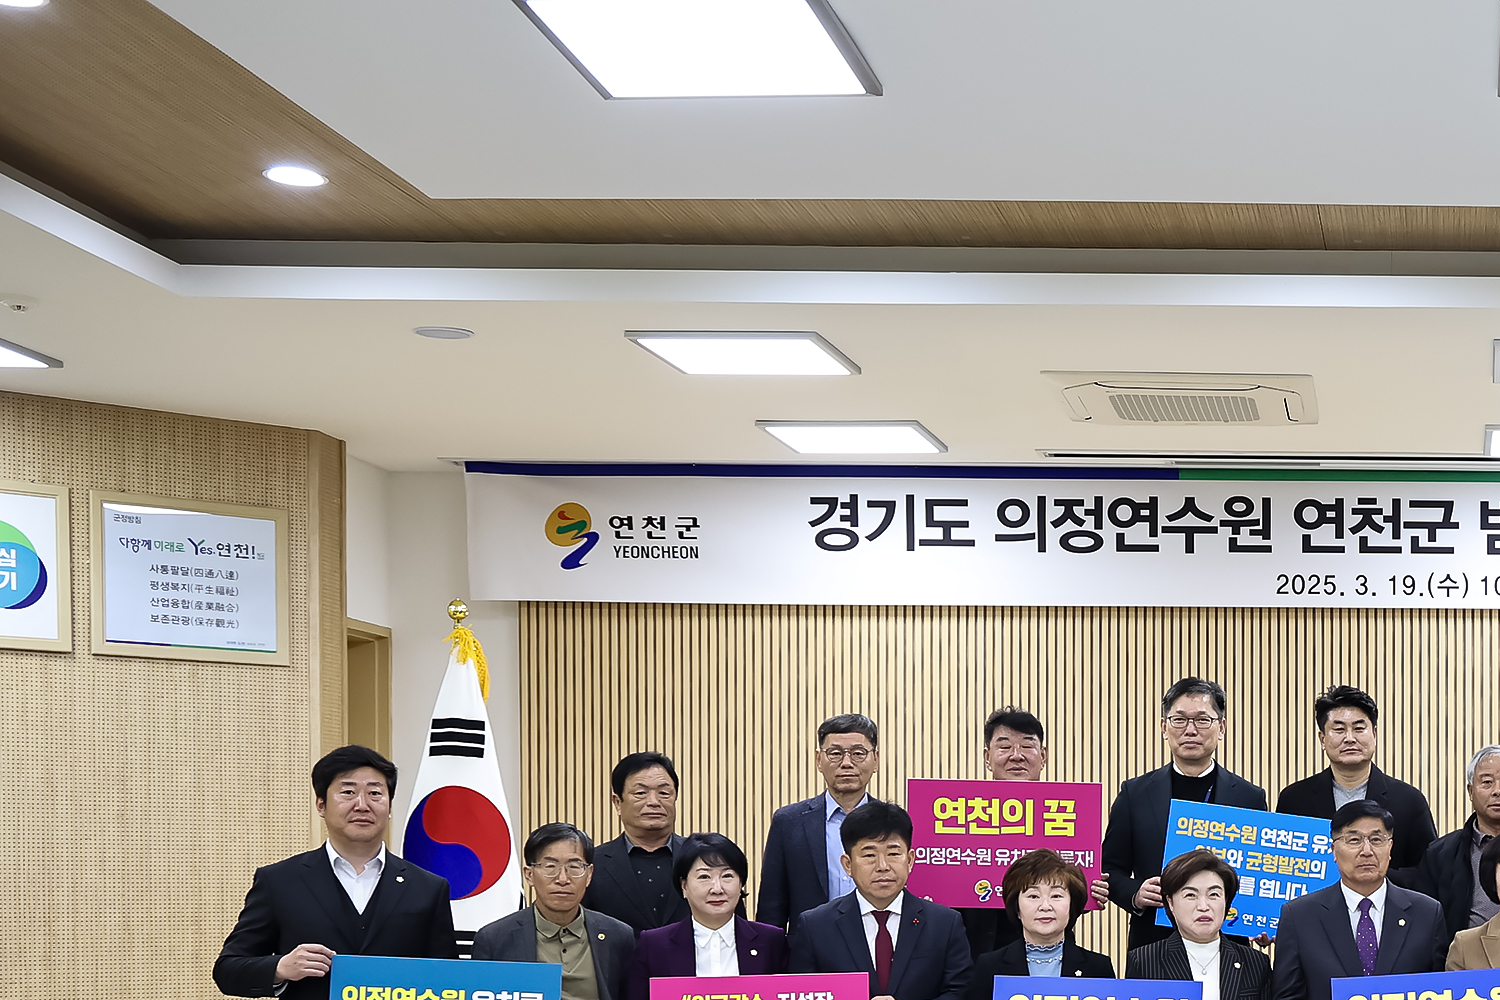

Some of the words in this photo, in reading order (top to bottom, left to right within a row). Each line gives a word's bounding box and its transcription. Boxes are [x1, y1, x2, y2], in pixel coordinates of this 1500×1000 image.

[113, 514, 142, 525] 군정방침
[608, 515, 701, 540] 연천군
[807, 493, 976, 552] 경기도
[995, 495, 1272, 554] 의정연수원
[1293, 497, 1460, 555] 연천군
[119, 536, 152, 553] 다함께
[153, 540, 186, 553] 미래로
[216, 542, 256, 560] 연천!
[613, 545, 699, 559] YEONCHEON
[1276, 574, 1346, 597] 2025.
[1355, 574, 1377, 597] 3.
[1388, 572, 1469, 600] 19.(수)
[933, 796, 1034, 836] 연천의
[1043, 799, 1077, 837] 꿈
[1175, 817, 1258, 845] 의정연수원
[1260, 828, 1309, 852] 연천군
[915, 847, 992, 866] 의정연수원
[1245, 851, 1327, 880] 균형발전의
[1242, 913, 1280, 929] 연천군
